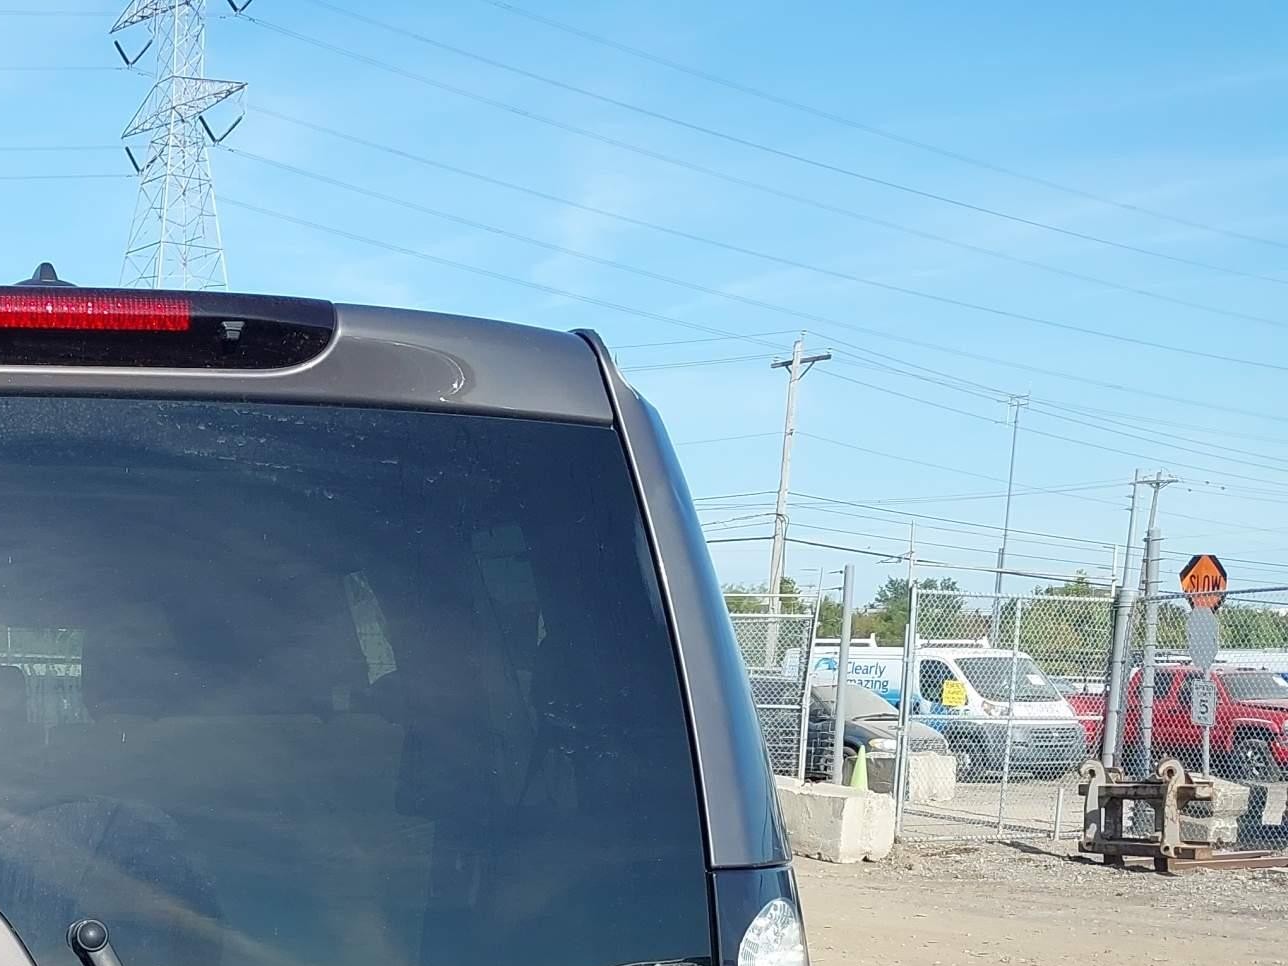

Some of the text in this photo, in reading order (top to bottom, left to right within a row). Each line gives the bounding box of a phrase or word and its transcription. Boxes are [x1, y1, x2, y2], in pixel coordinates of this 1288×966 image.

[1189, 574, 1222, 593] SLOW
[846, 676, 889, 693] azing
[1199, 699, 1209, 715] 5
